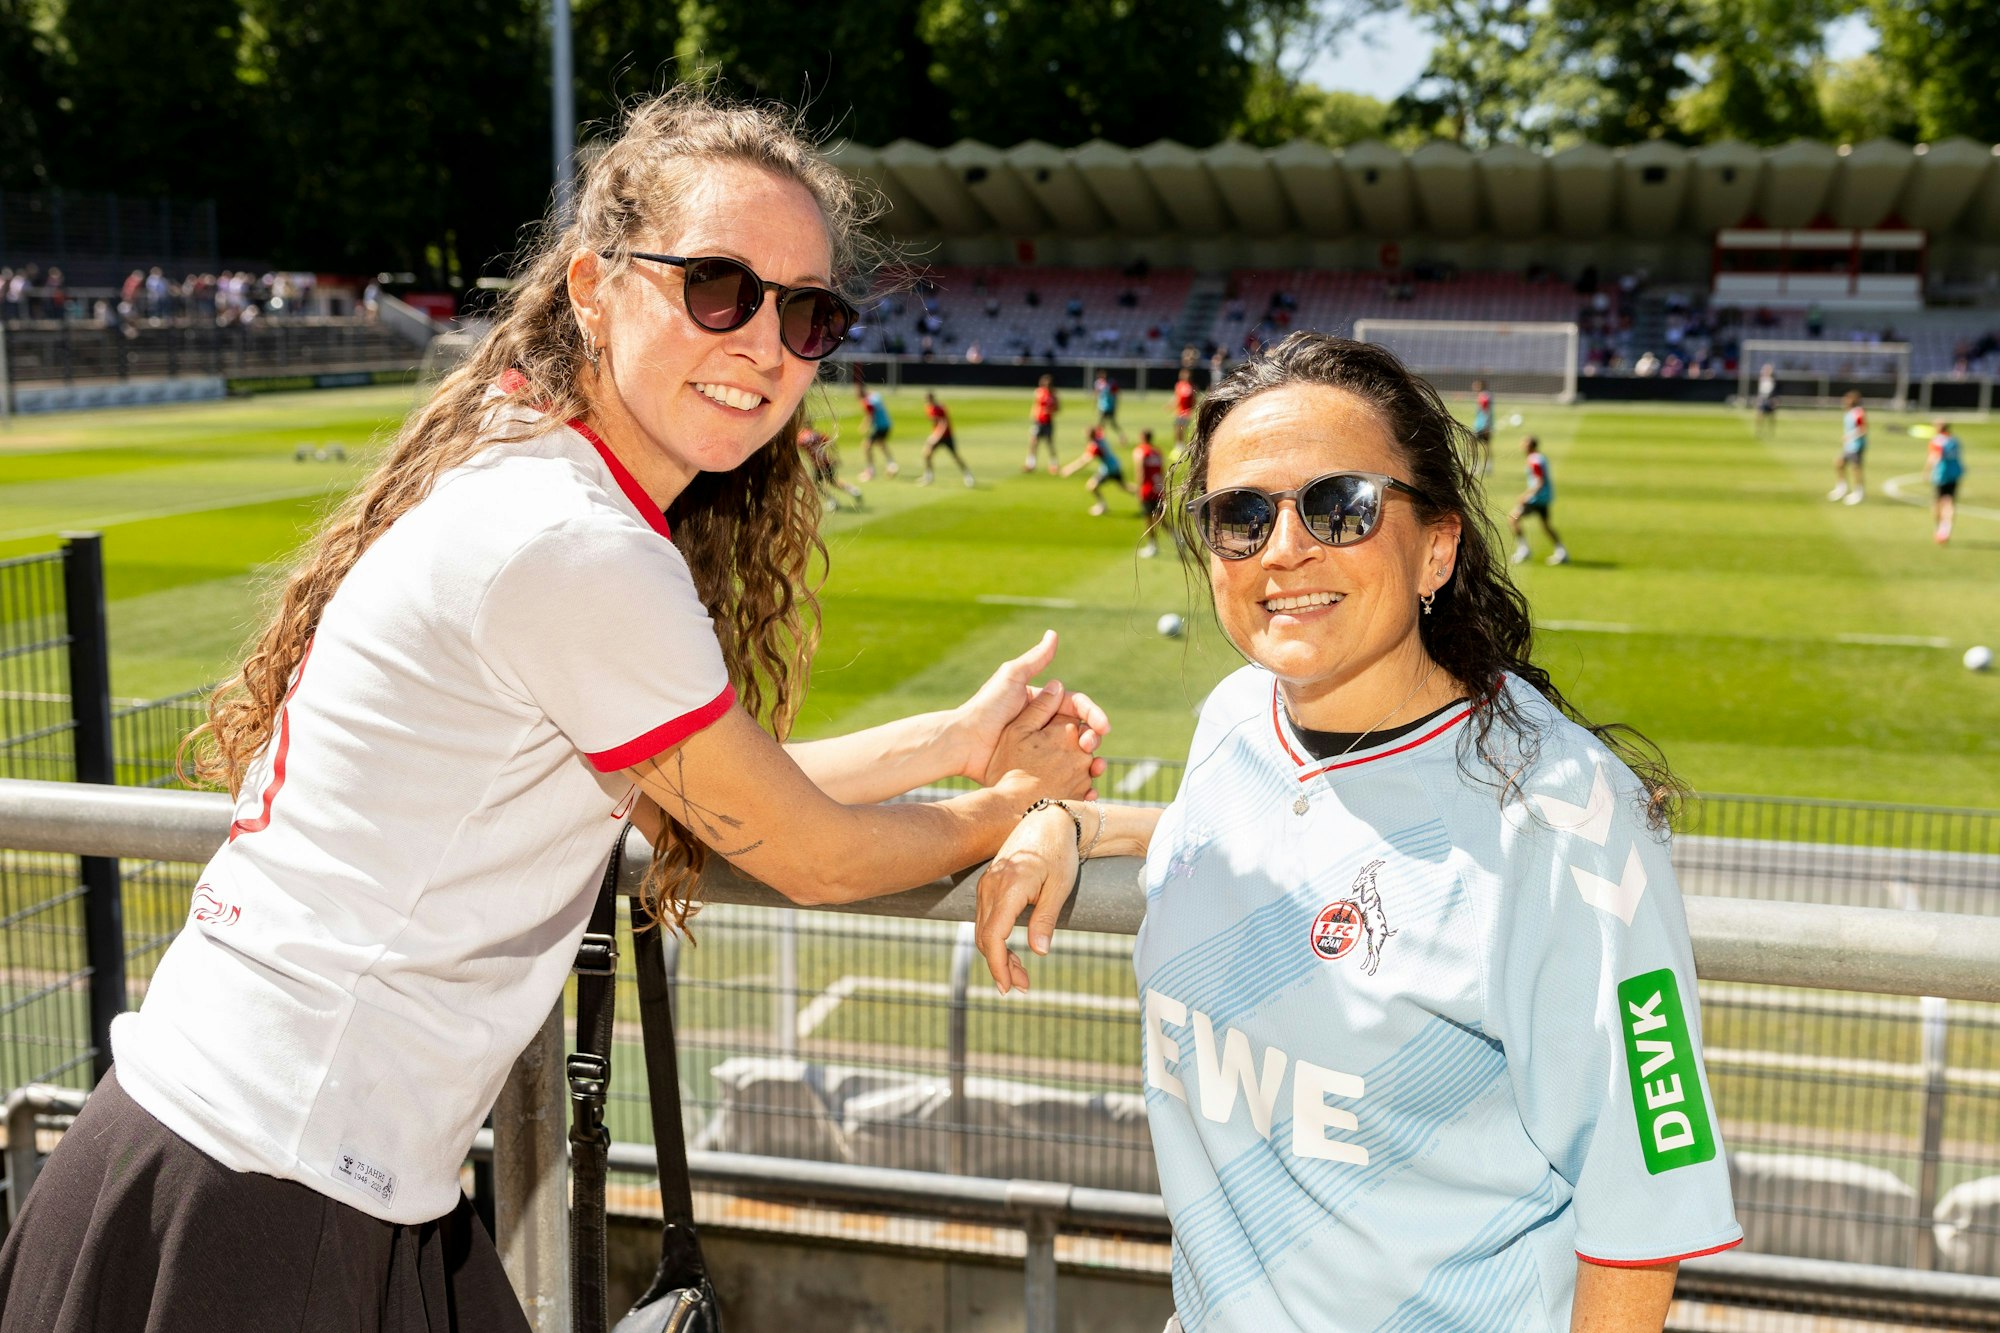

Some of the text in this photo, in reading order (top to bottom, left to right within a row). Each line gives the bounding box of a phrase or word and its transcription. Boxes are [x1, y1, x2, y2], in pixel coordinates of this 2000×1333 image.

[1320, 923, 1354, 936] 1. FC
[1318, 936, 1342, 949] KÖLN
[1146, 988, 1370, 1166] EWE
[1628, 990, 1695, 1153] DEVK
[356, 1161, 365, 1171] 75
